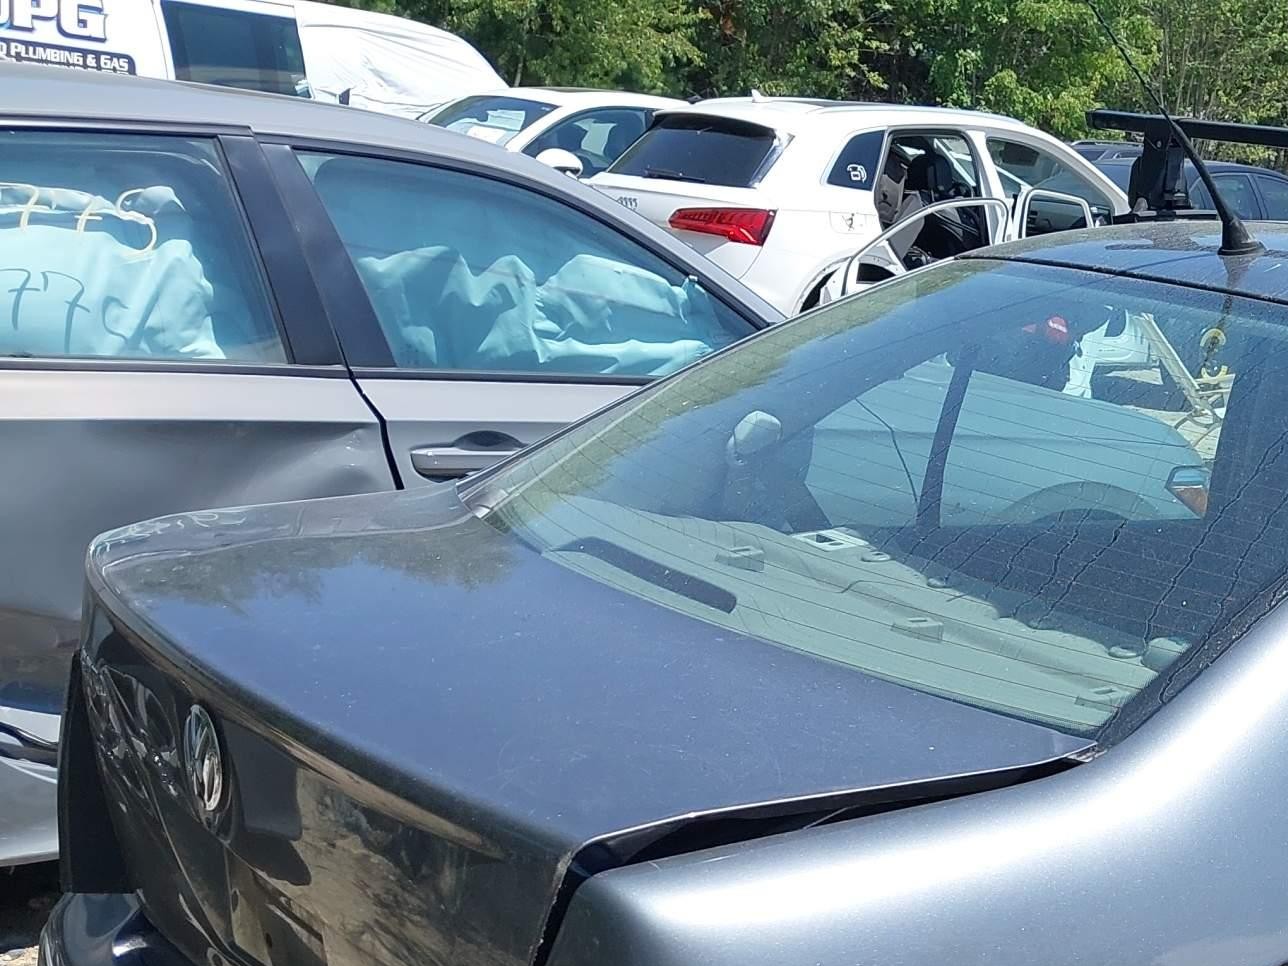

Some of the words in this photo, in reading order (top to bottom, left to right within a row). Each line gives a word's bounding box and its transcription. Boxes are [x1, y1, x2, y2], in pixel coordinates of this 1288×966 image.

[0, 0, 107, 43] PG
[9, 41, 84, 66] PLUMBING
[86, 54, 98, 68] &
[100, 54, 129, 71] GAS
